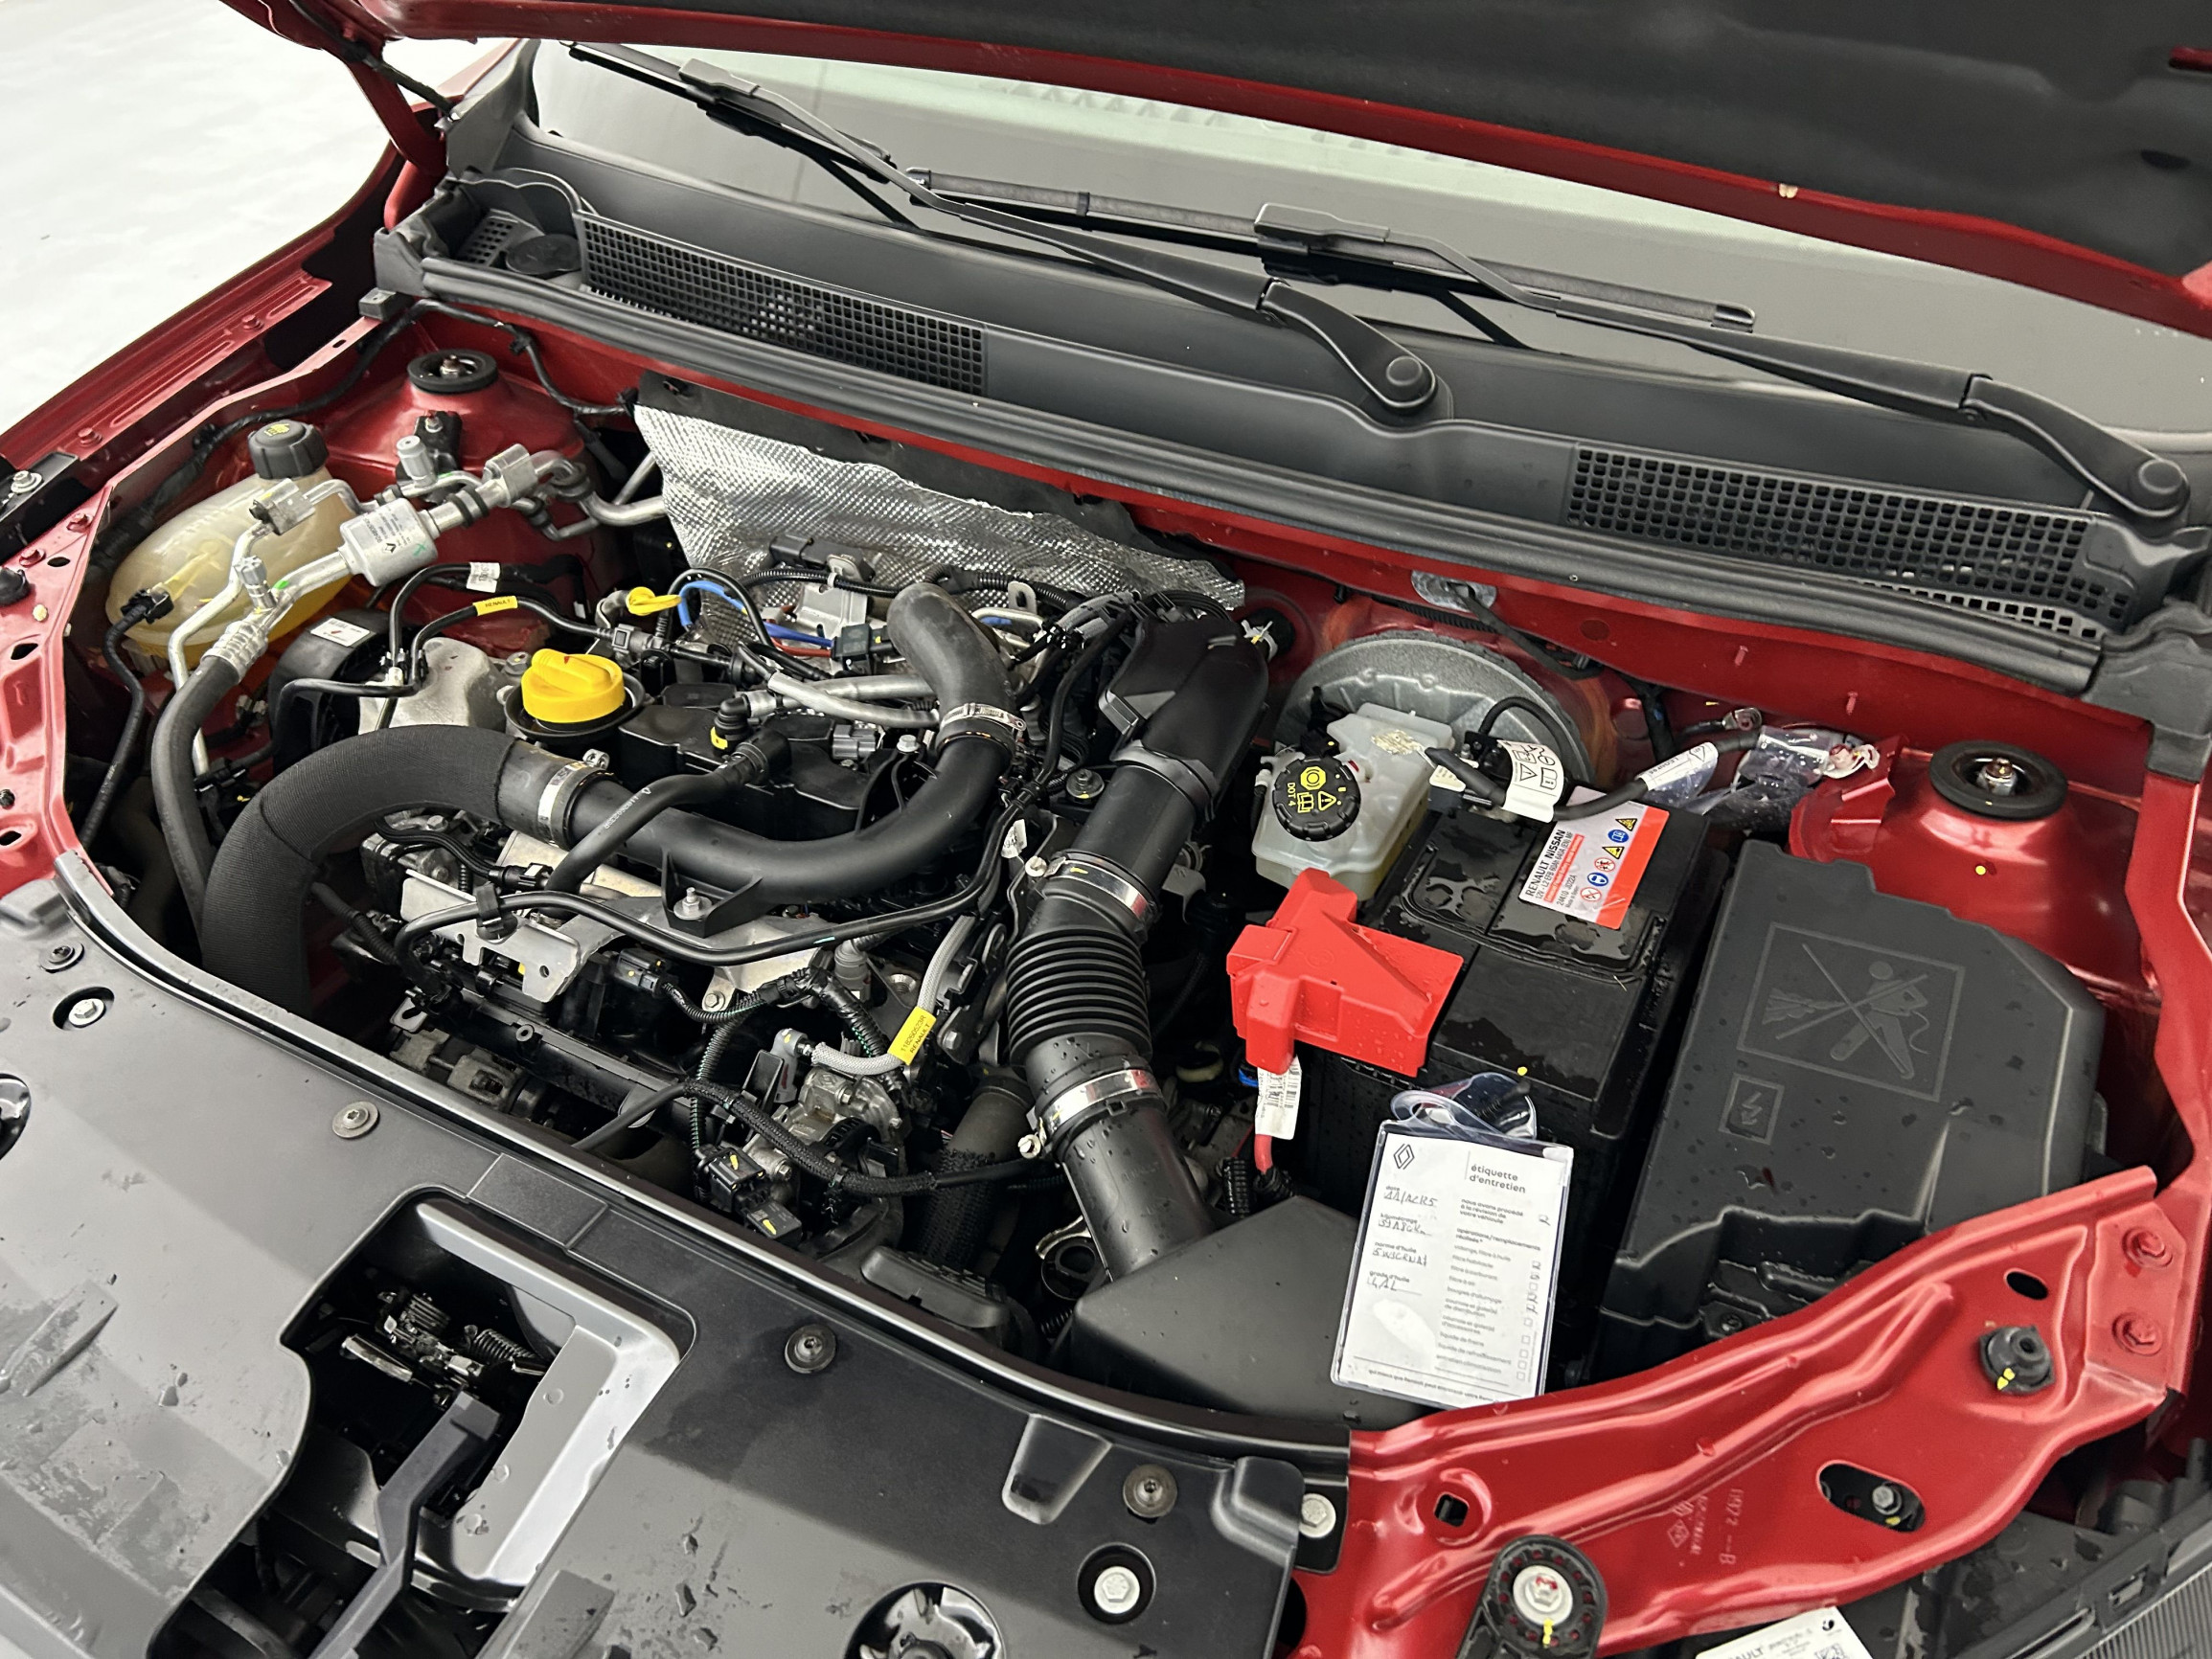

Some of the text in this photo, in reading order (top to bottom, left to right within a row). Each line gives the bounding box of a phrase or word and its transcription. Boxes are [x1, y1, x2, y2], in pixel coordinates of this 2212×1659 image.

[1288, 782, 1296, 799] DOT
[1524, 859, 1549, 897] RENAULT
[1543, 828, 1565, 859] NISSAN
[1543, 870, 1554, 881] EFB
[910, 1023, 929, 1053] RENAULT
[1469, 1172, 1527, 1193] d'entretien
[1470, 1163, 1519, 1183] étiquette
